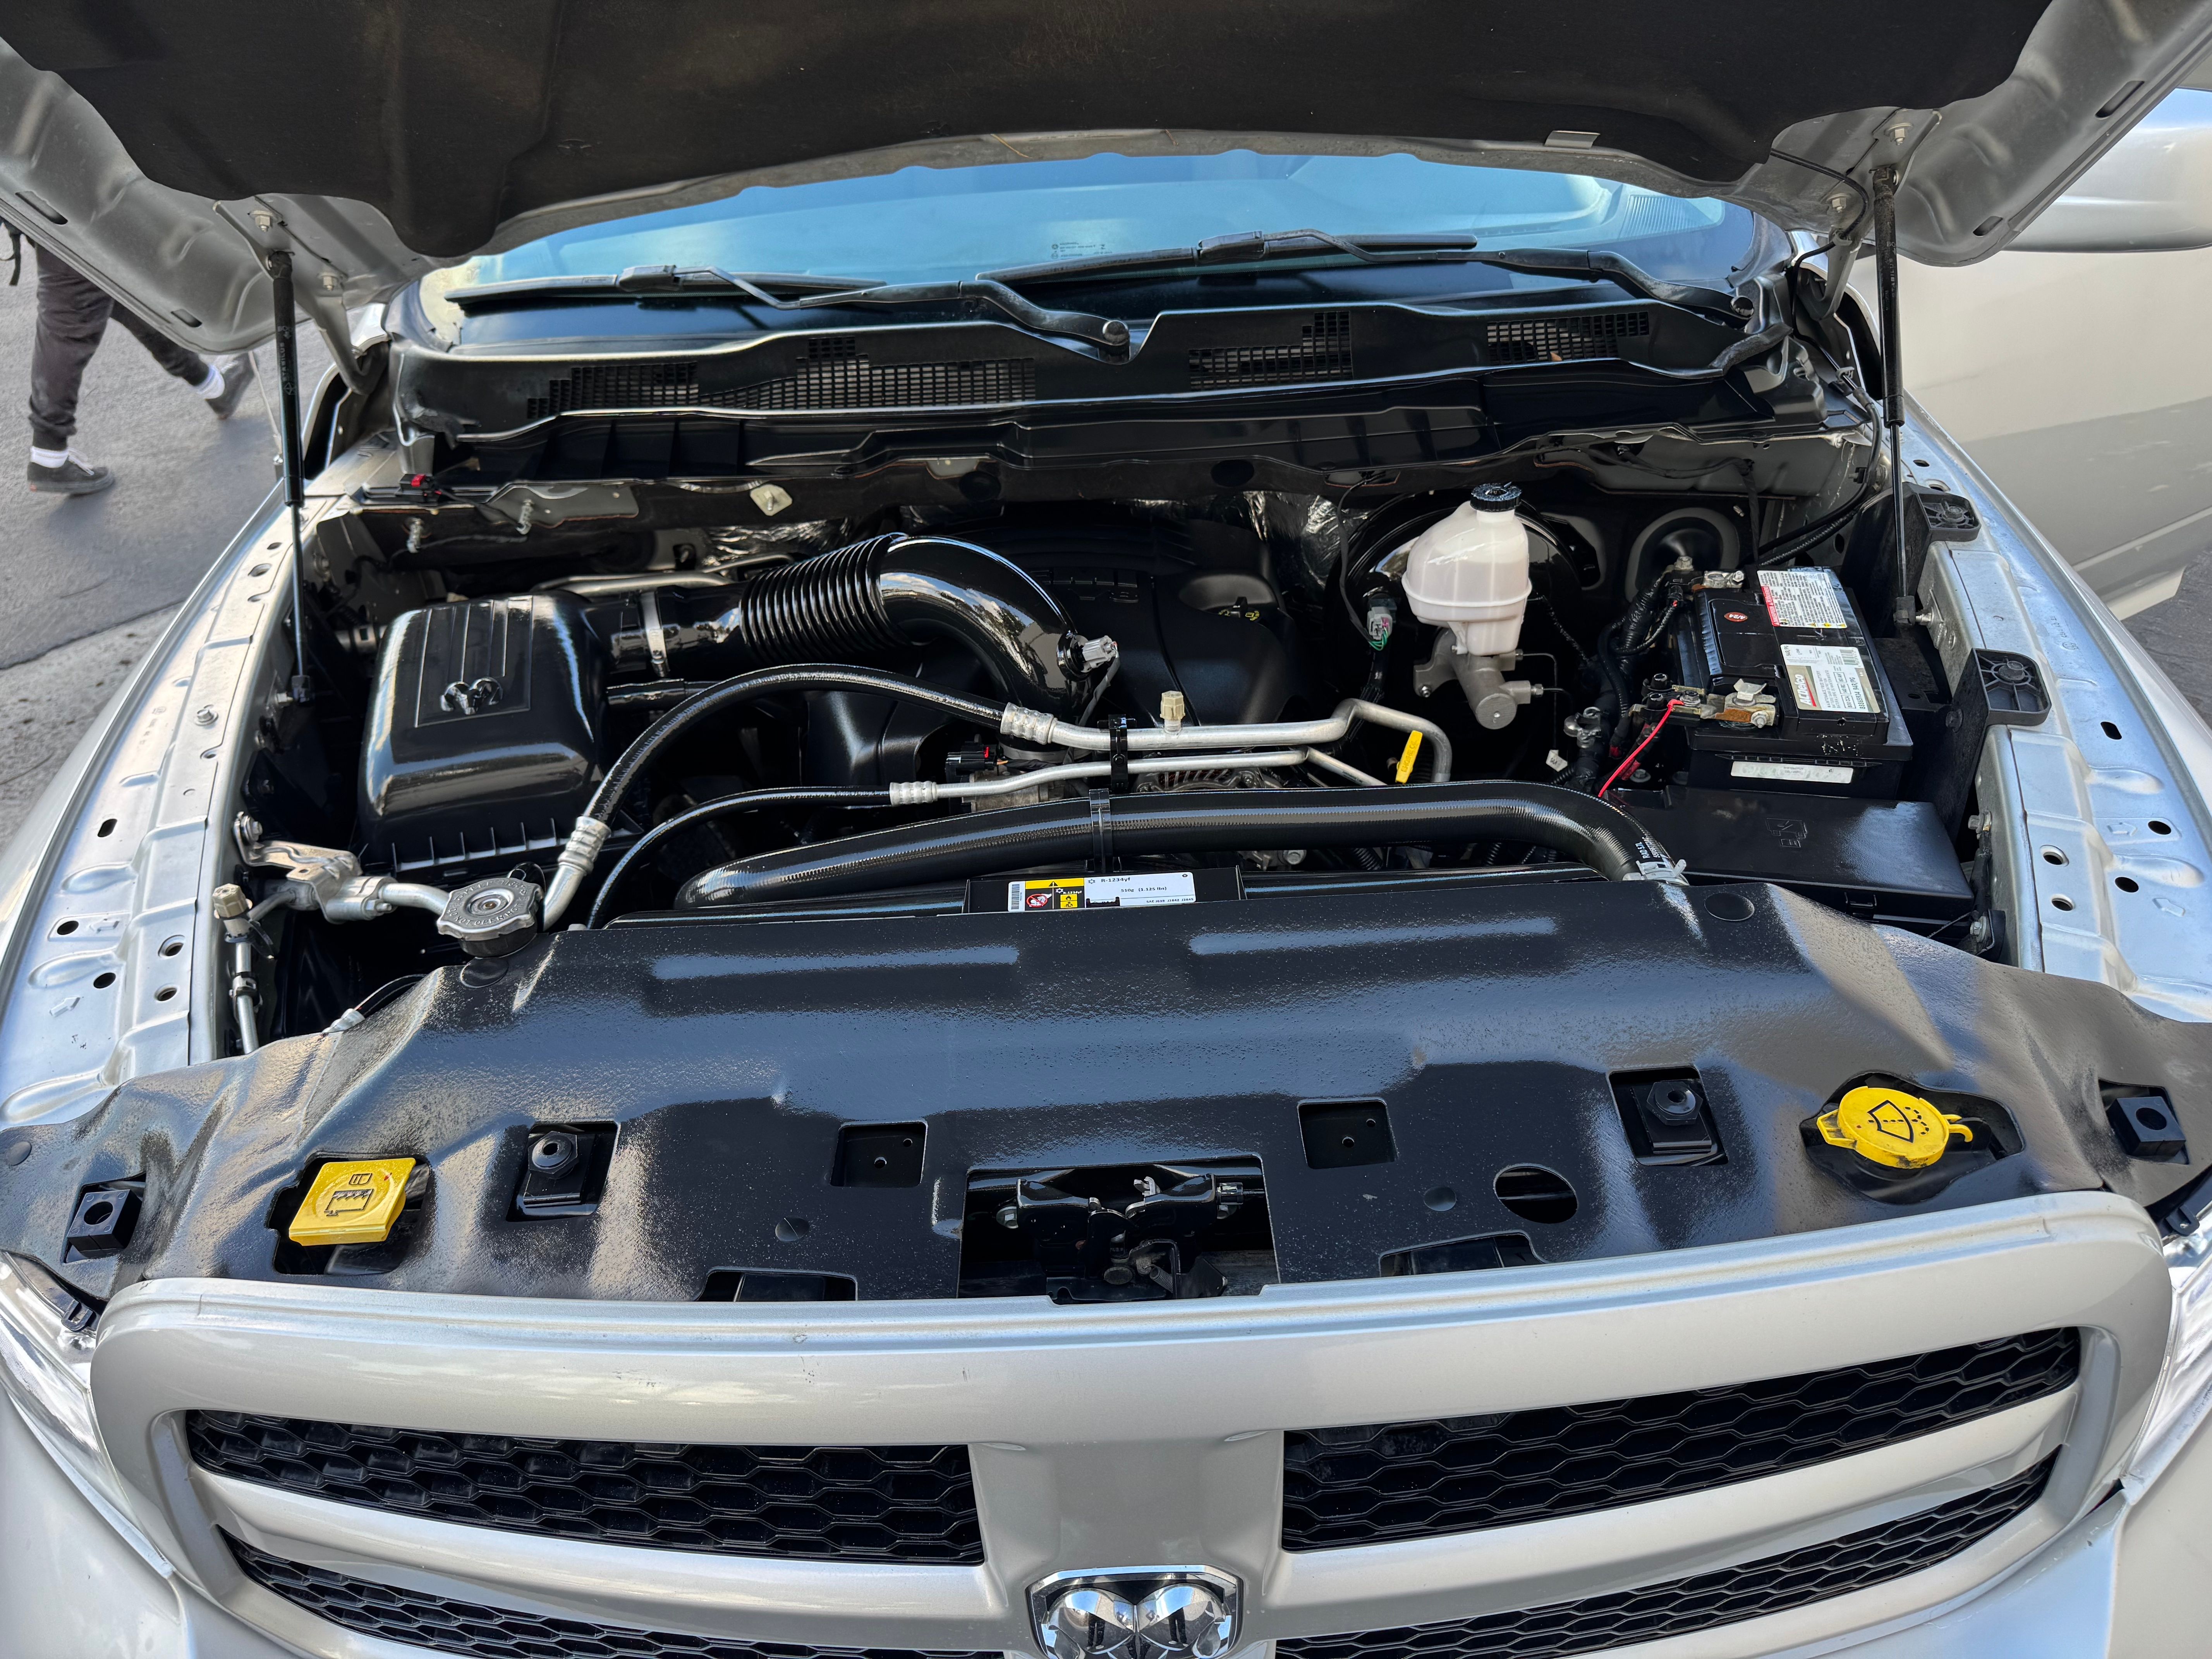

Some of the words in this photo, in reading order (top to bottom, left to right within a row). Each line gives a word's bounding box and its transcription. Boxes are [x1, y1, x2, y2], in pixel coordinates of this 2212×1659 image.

[1795, 674, 1812, 706] ACDelco
[1850, 677, 1860, 690] 94R/PG
[1821, 689, 1831, 707] MAINTENANCE
[1640, 850, 1650, 859] RAD
[456, 915, 473, 925] NOT
[474, 914, 505, 925] OPEN
[505, 903, 524, 917] HOT
